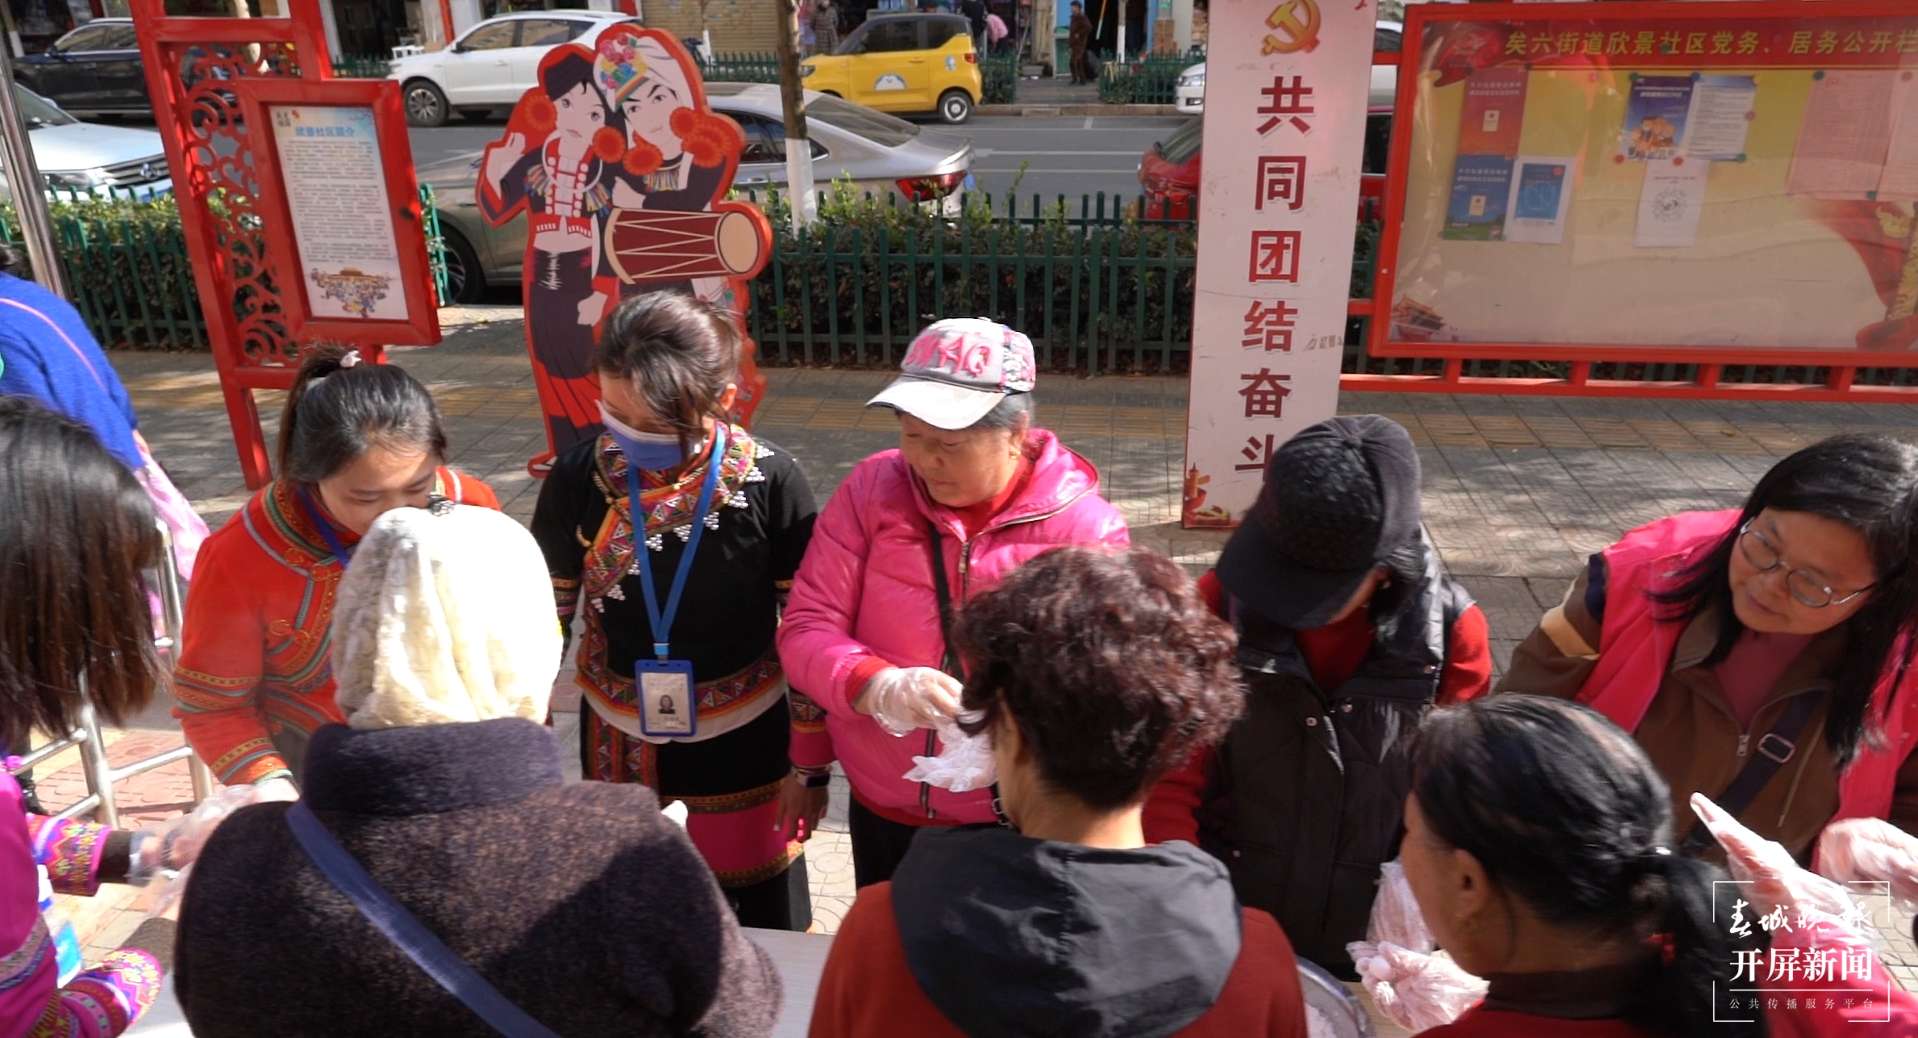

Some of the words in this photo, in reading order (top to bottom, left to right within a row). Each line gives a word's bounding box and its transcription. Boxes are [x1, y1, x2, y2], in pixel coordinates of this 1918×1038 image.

[1235, 75, 1314, 473] 共同团结奋斗
